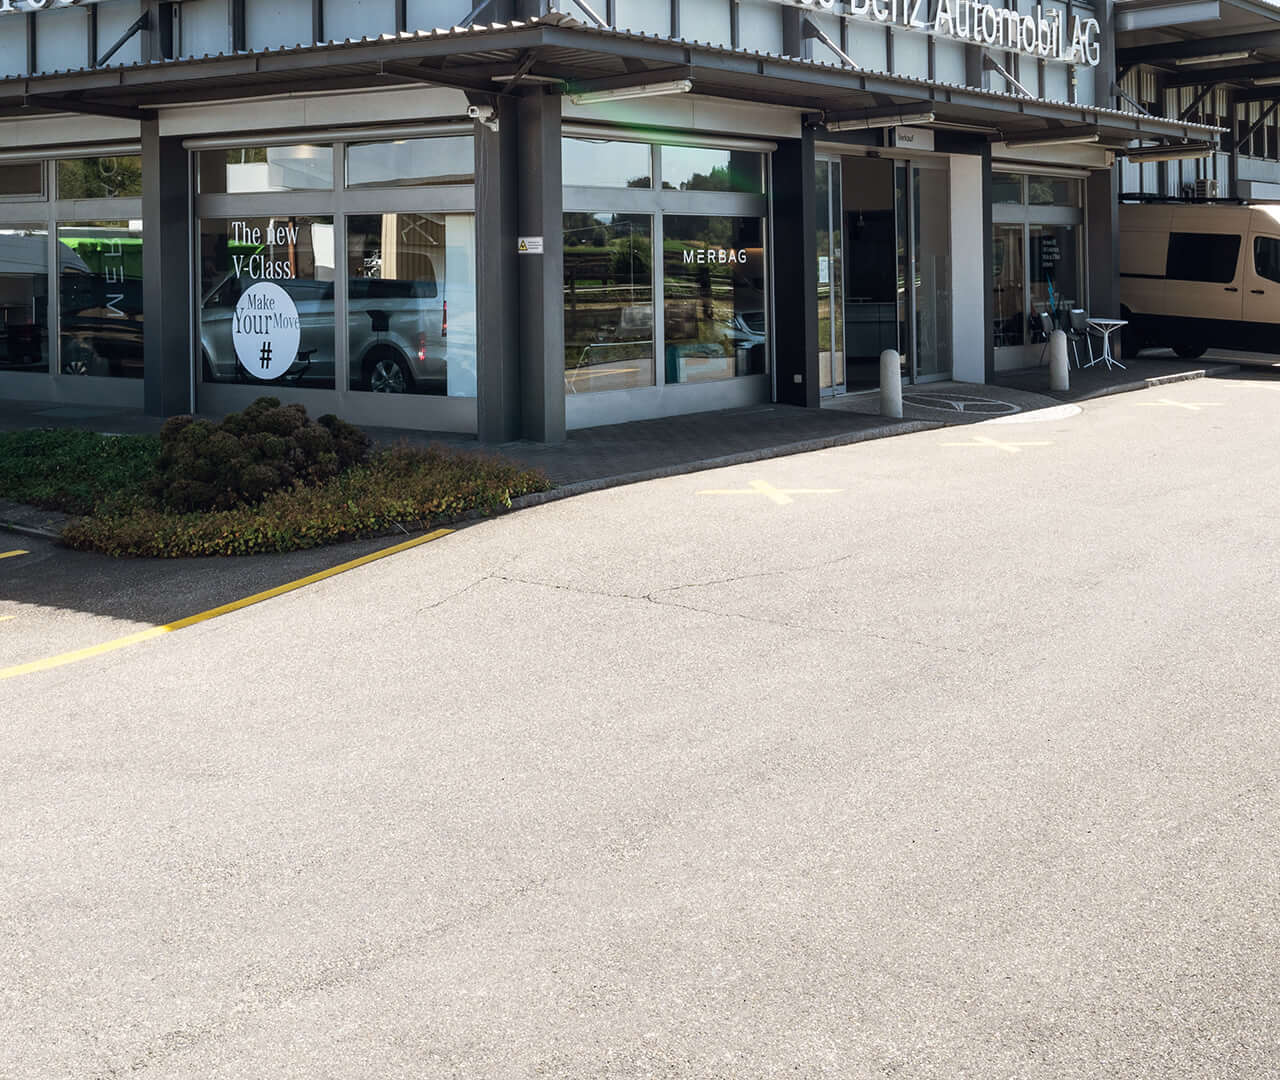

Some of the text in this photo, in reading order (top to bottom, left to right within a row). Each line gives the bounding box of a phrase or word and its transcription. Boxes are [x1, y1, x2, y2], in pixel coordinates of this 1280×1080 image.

[1068, 14, 1100, 67] AG
[232, 221, 300, 246] The new
[232, 254, 296, 280] V-Class.
[683, 249, 747, 264] MERBAG
[247, 294, 275, 311] Make
[234, 307, 299, 335] Your Move
